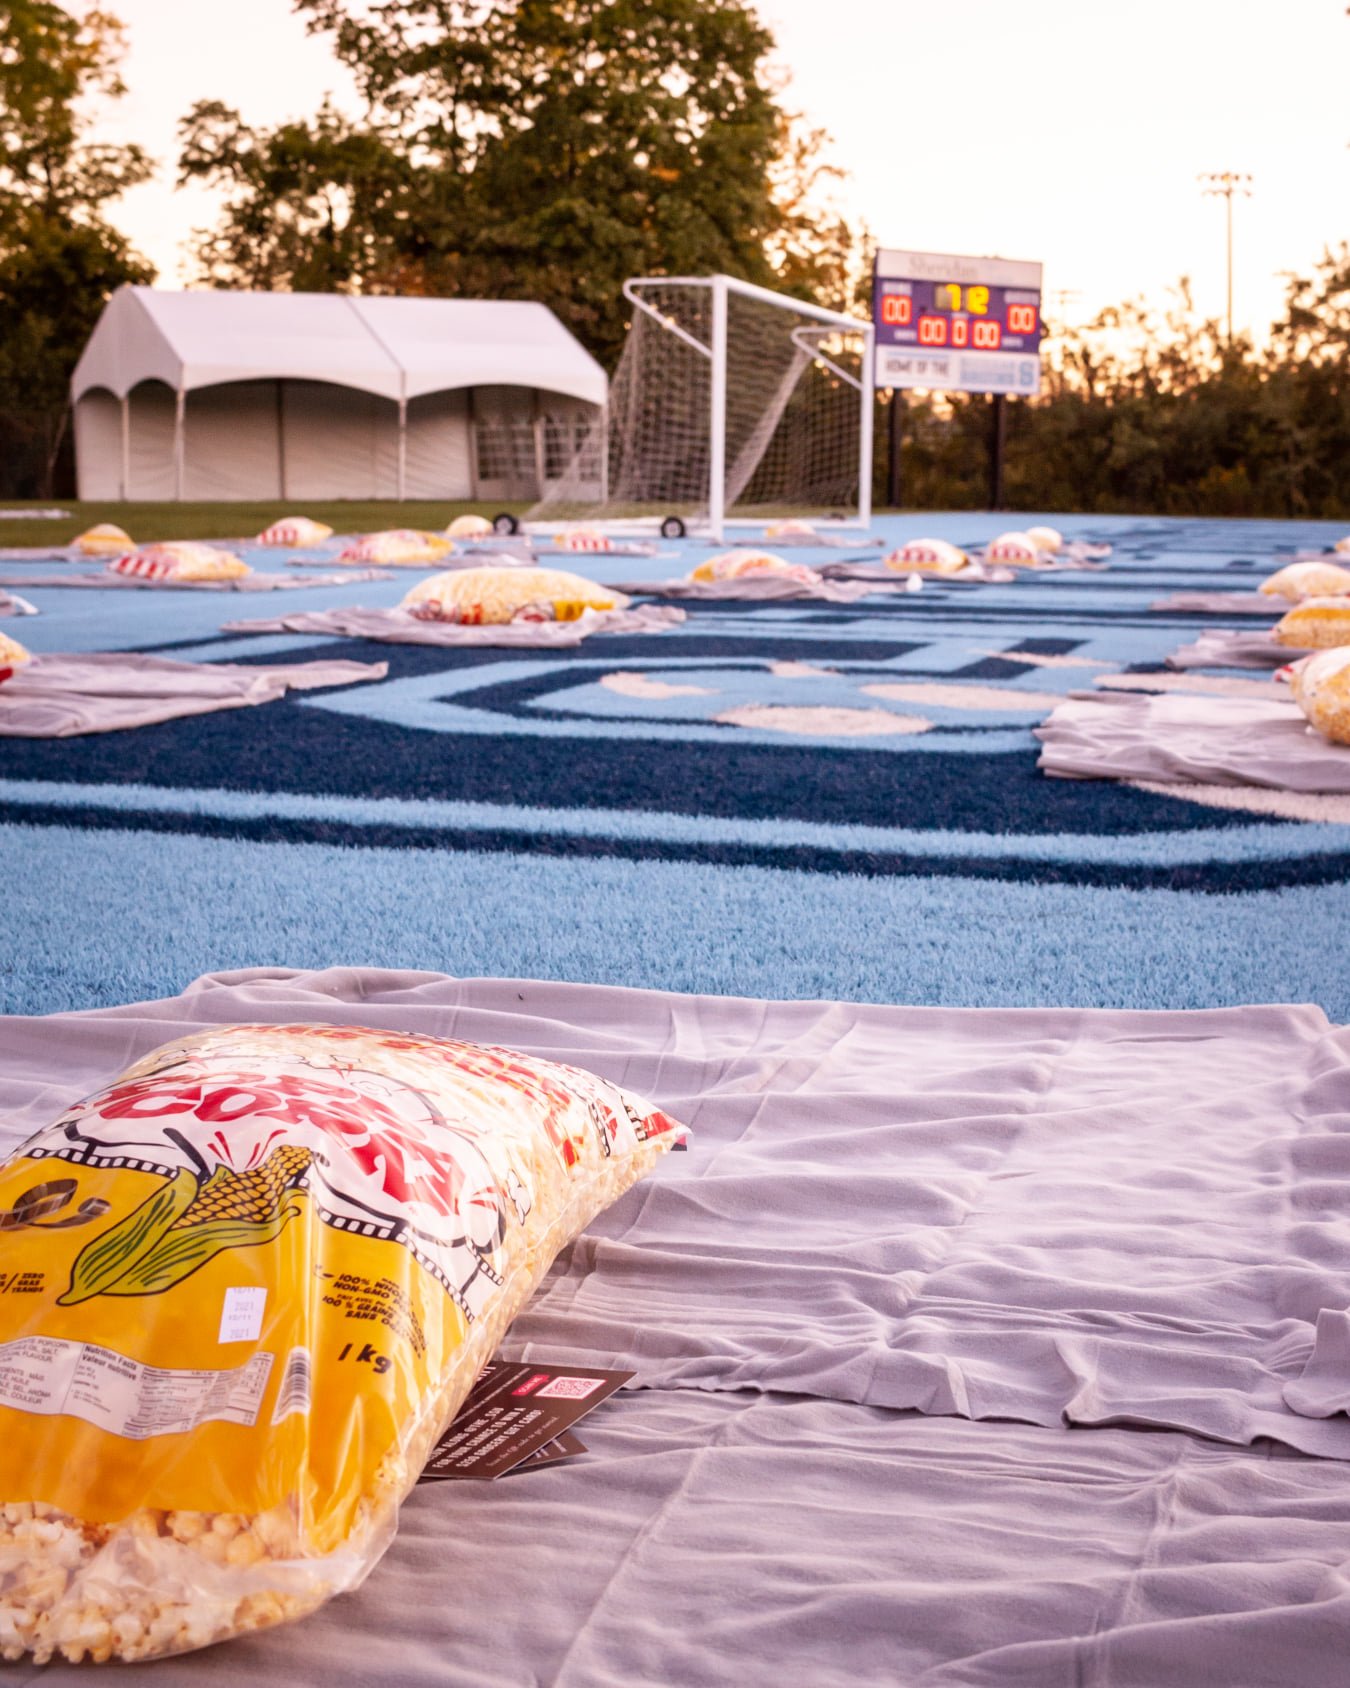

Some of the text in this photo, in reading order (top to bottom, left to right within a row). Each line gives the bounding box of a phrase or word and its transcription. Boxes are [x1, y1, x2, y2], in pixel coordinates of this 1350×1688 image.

[882, 296, 912, 325] 00
[1007, 304, 1036, 334] 00
[918, 316, 947, 345] 00
[952, 319, 968, 347] 0
[972, 320, 1000, 349] 00
[99, 1086, 450, 1217] CORN
[333, 1281, 391, 1300] NON-GMO
[338, 1273, 371, 1286] 100%
[322, 1295, 343, 1308] 100
[356, 1303, 395, 1319] GRAINS
[345, 1309, 379, 1321] SANS
[81, 1353, 108, 1367] Valeur
[84, 1345, 138, 1371] Nutrition Facts
[337, 1343, 393, 1375] 1 kg
[431, 1458, 452, 1468] FOR
[446, 1446, 471, 1458] YOUR
[465, 1428, 497, 1446] CHANCE
[499, 1411, 520, 1421] WIN
[472, 1434, 510, 1455] GROCERY
[502, 1423, 525, 1435] GIFT
